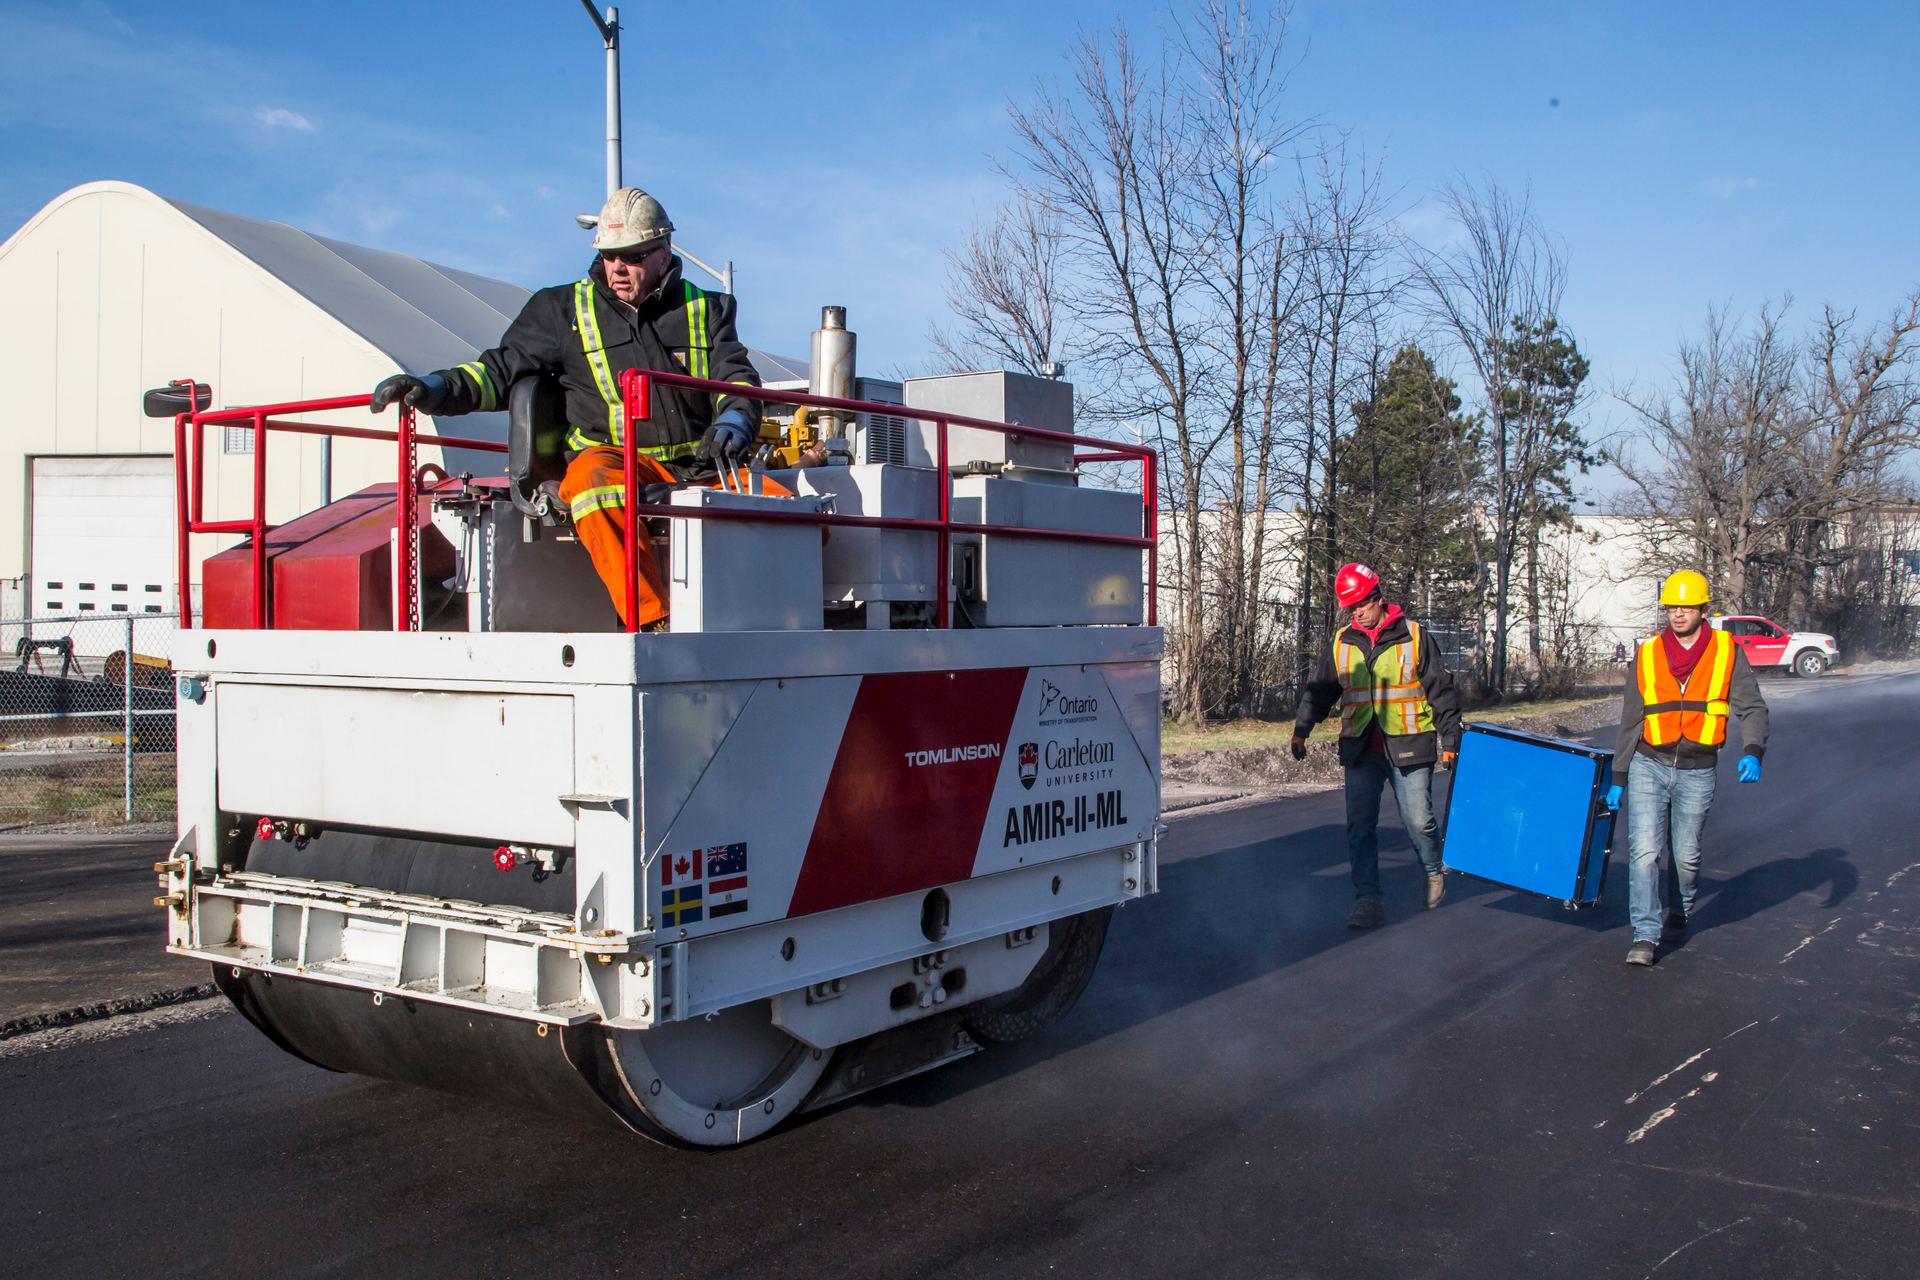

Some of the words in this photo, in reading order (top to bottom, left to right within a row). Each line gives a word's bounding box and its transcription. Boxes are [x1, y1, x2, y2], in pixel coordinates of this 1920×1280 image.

[1059, 695, 1098, 715] Ontario
[1063, 715, 1098, 725] TRANSPORTATION
[904, 742, 1000, 768] TOMLINSON
[1045, 737, 1115, 770] Carleton
[1046, 768, 1114, 788] UNIVERSITY
[1003, 789, 1128, 848] AMIR-II-ML
